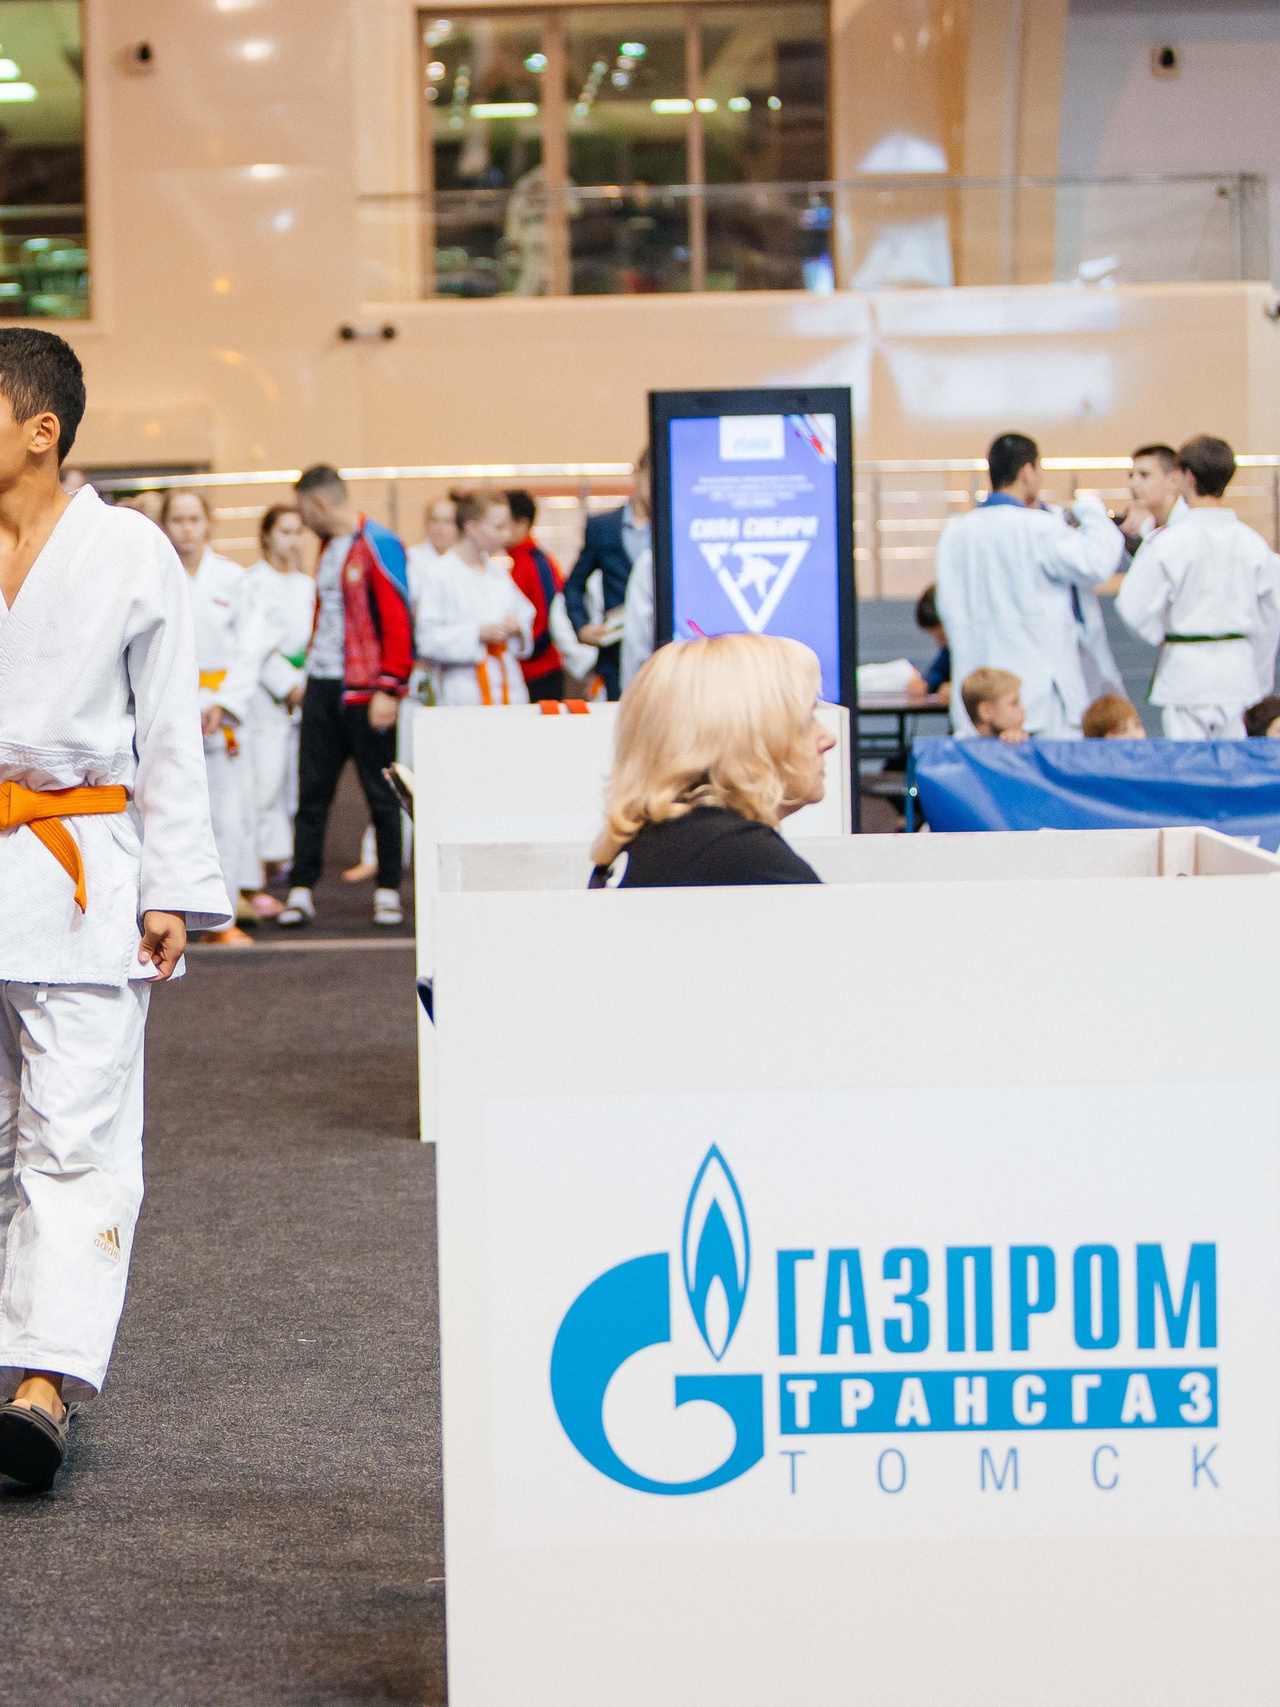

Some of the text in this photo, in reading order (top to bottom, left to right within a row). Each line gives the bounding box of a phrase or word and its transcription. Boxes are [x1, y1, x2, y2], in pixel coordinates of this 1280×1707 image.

[776, 1242, 1218, 1356] ГАЗПРОМ
[785, 1371, 1213, 1429] ТРАНСГАЗ
[779, 1442, 1220, 1495] ТОМСК
